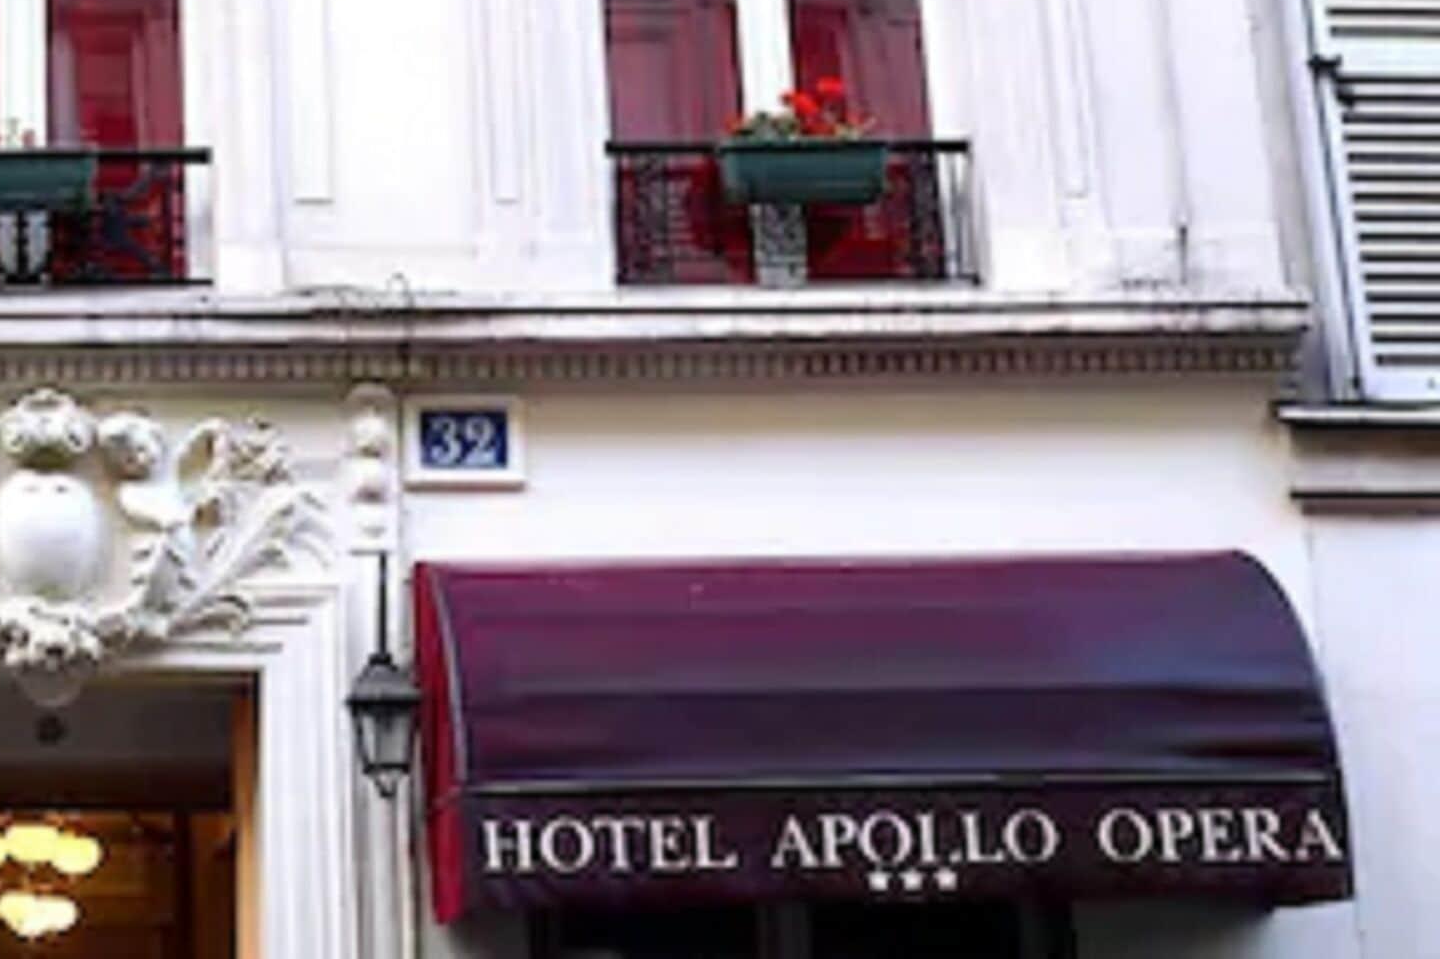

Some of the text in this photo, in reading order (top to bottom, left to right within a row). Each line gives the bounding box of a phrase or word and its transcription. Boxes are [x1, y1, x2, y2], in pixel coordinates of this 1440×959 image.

[429, 414, 495, 466] 32
[482, 806, 1344, 874] HOTEL APOLLO OPERA
